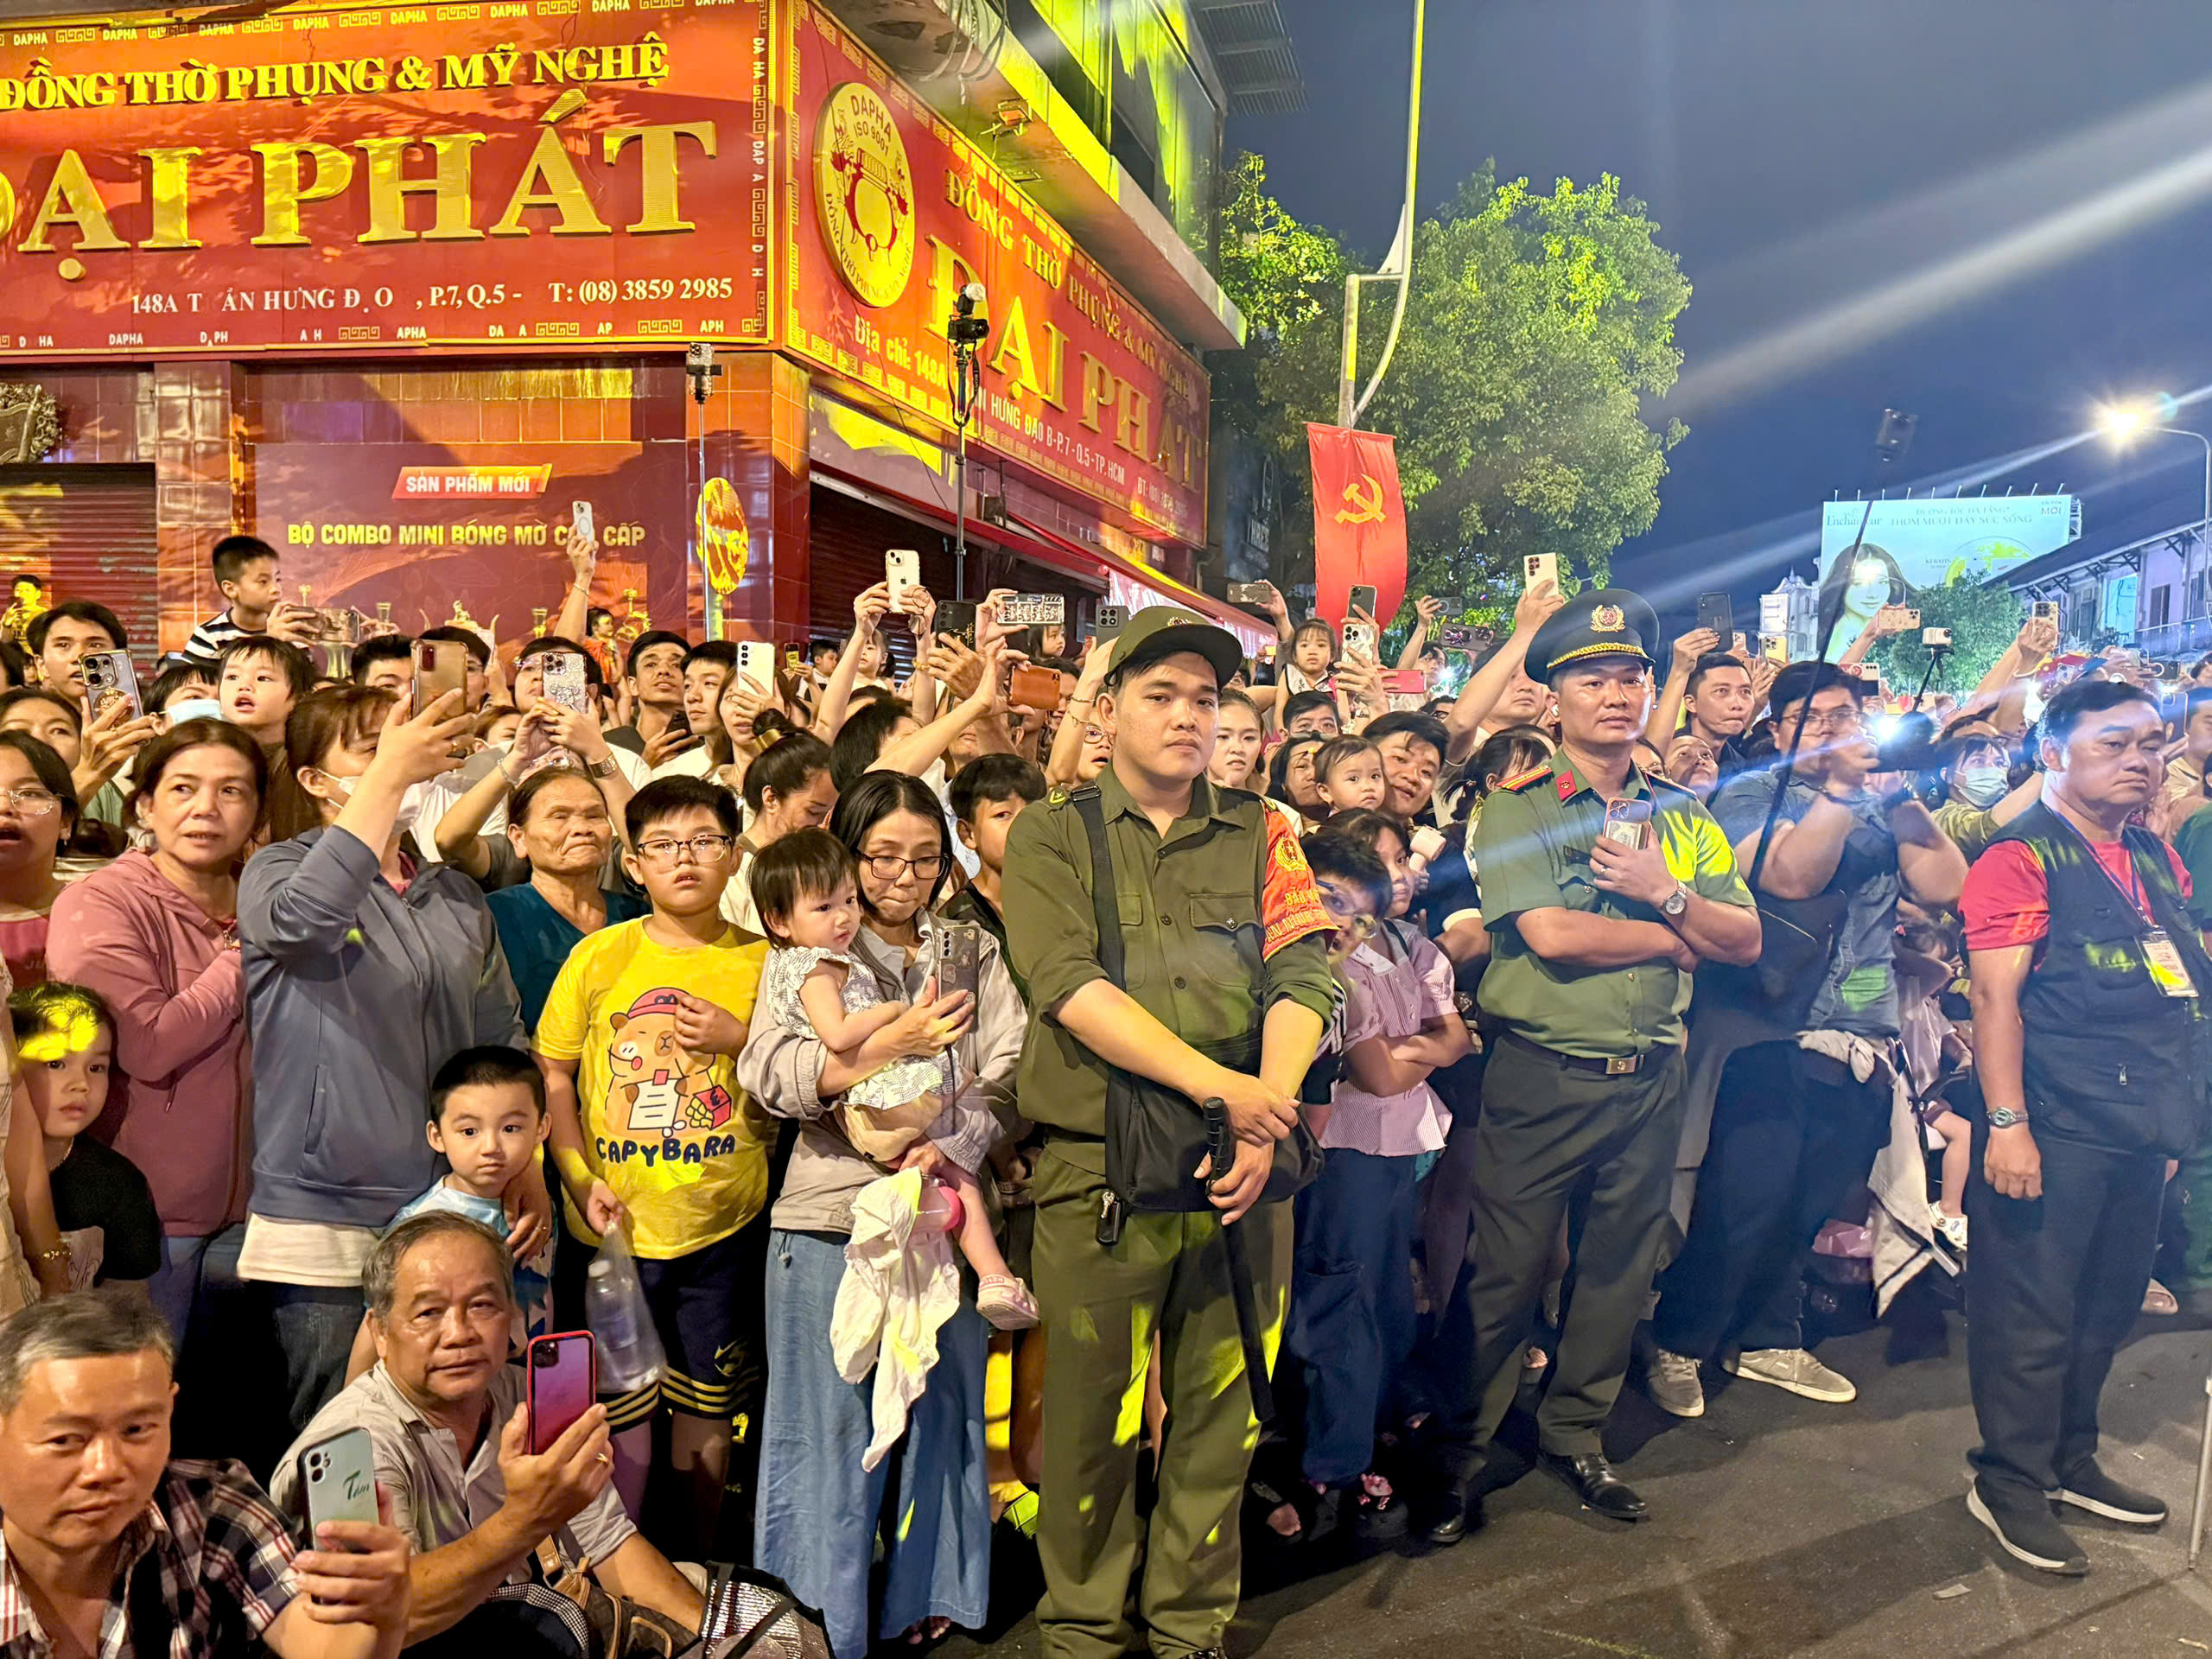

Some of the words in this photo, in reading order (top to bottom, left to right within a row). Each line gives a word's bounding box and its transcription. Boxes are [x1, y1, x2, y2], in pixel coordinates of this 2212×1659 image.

[293, 16, 329, 30] DAPHA
[391, 10, 427, 23] DAPHA
[490, 4, 528, 18] DAPHA
[13, 32, 48, 46] DAPHA
[102, 29, 137, 41] DAPHA
[199, 22, 234, 35] DAPHA
[124, 58, 218, 105] THỜ
[226, 57, 388, 105] PHỤNG
[395, 55, 433, 90] &
[442, 42, 520, 88] MỸ
[532, 31, 671, 87] NGHỆ
[849, 94, 892, 143] DAPHA
[853, 120, 869, 138] ISO
[870, 125, 889, 156] 9001
[251, 88, 718, 246] PHÁT
[944, 168, 1014, 251] ĐỒNG
[1022, 233, 1062, 290] THỜ
[132, 293, 179, 314] 148A
[263, 286, 336, 311] HƯNG
[467, 283, 506, 309] Q.5
[578, 279, 618, 305] (08)
[621, 278, 675, 301] 3859
[679, 277, 733, 300] 2985
[109, 333, 143, 346] DAPHA
[990, 393, 1021, 431] HƯNG
[406, 471, 440, 493] SẢN
[288, 521, 315, 549] BỘ
[321, 524, 392, 545] COMBO
[398, 524, 445, 546] MINI
[451, 518, 507, 546] BÓNG
[603, 521, 646, 547] CẤP
[596, 1134, 735, 1167] CAPYBARA
